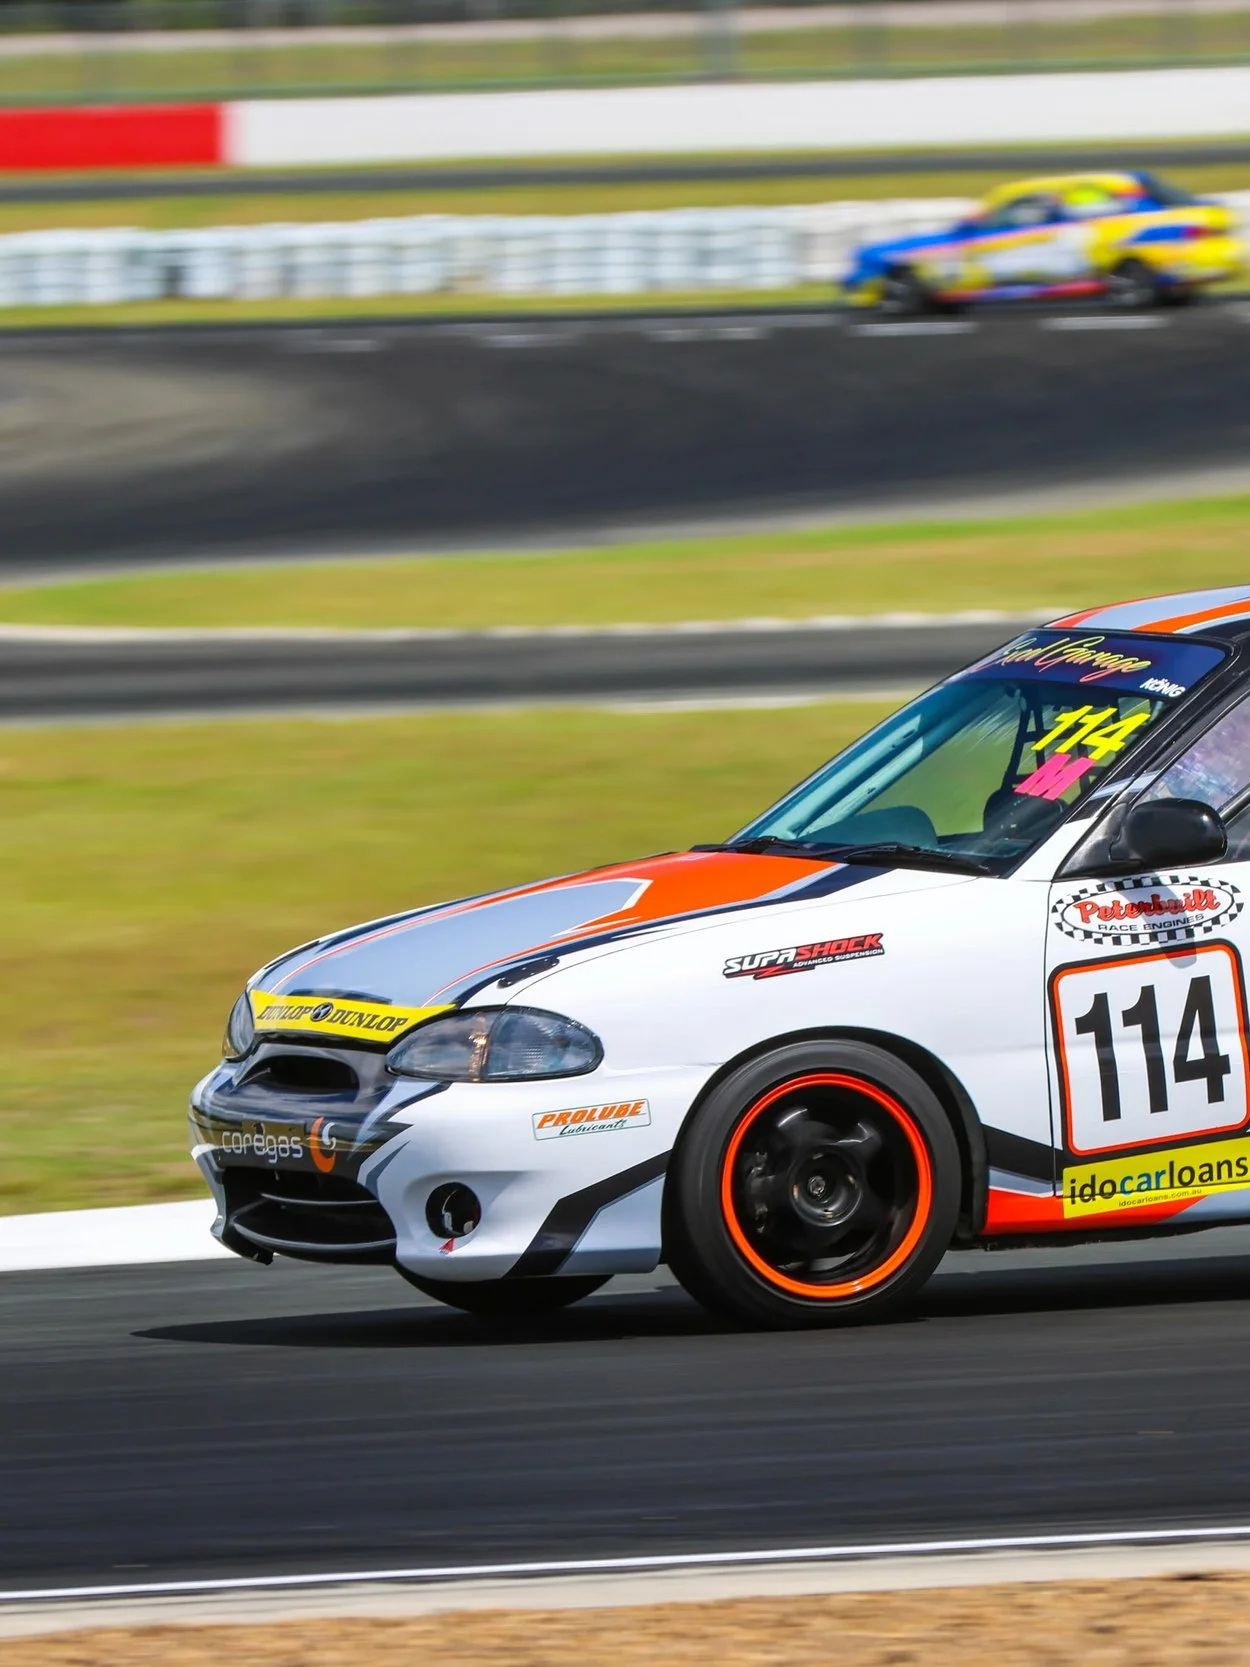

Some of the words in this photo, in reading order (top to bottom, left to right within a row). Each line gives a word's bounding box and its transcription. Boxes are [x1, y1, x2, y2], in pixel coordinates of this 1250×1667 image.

[1034, 635, 1152, 682] Garage
[1139, 677, 1187, 698] KÖNIG
[1030, 704, 1151, 761] 114
[1072, 888, 1221, 924] Peterbuilt
[1098, 923, 1138, 932] RACE
[1143, 913, 1205, 930] ENGINES
[724, 934, 882, 975] SUPASHOCK
[793, 956, 833, 968] ADVANCED
[835, 948, 884, 961] SUSPENSION
[257, 1005, 313, 1020] DUNLOP
[327, 1009, 409, 1032] DUNLOP
[1074, 975, 1232, 1122] 114
[537, 1101, 646, 1129] PROLUBE
[559, 1118, 628, 1136] Lubricants
[221, 1131, 303, 1163] coregas
[1070, 1156, 1249, 1205] idocarloans
[1118, 1188, 1202, 1207] idocarloans.com.au
